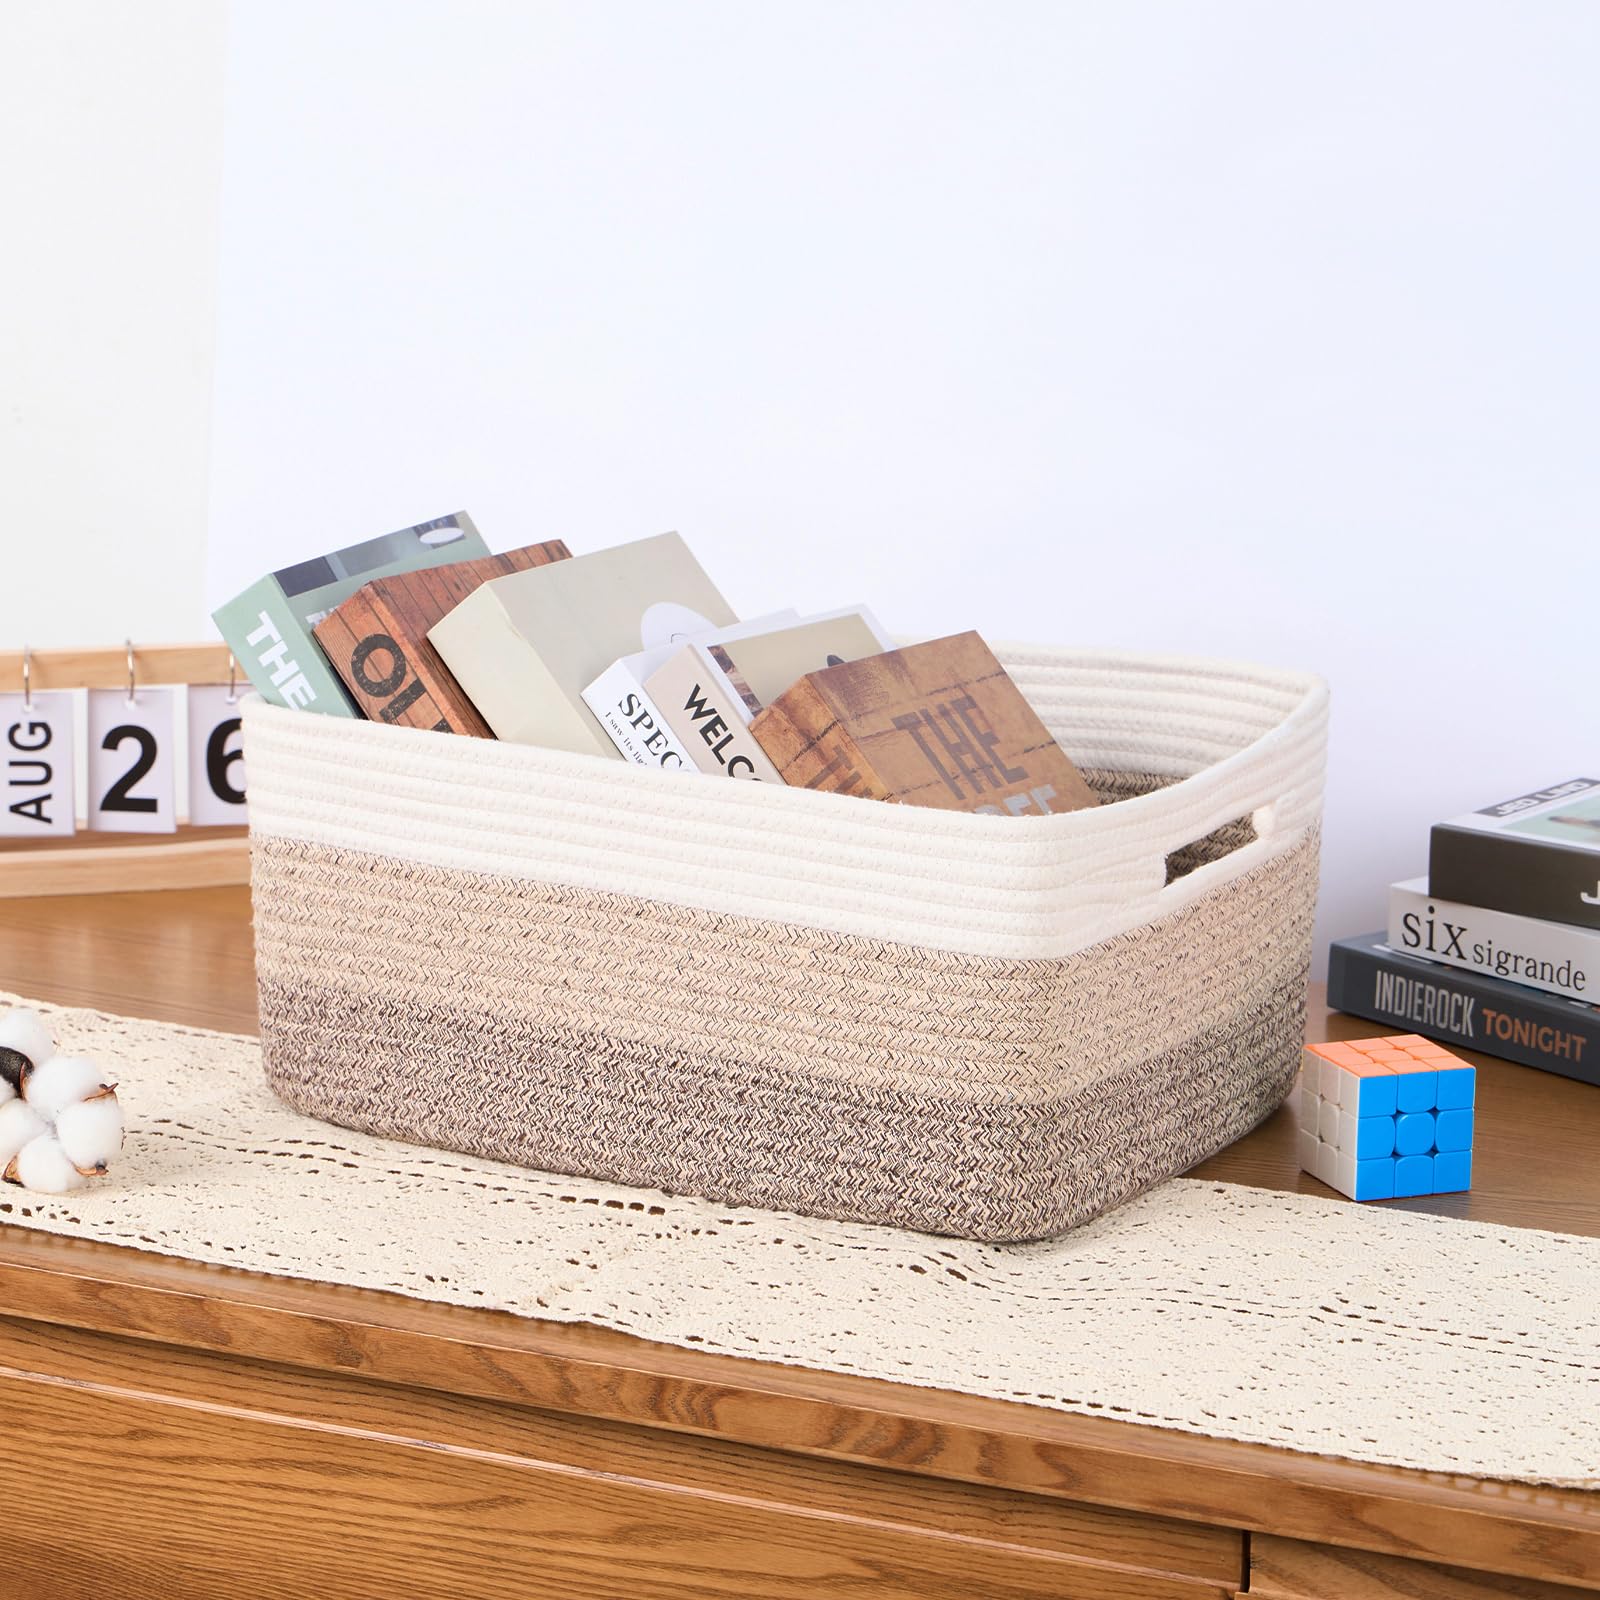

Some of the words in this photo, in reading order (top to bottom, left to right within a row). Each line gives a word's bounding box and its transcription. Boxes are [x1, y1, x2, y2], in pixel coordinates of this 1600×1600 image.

[246, 610, 317, 711] THE
[8, 721, 53, 824] AUG
[99, 724, 158, 814] 2
[206, 717, 247, 805] 6
[683, 683, 763, 781] WELC
[891, 695, 1029, 800] THE
[1472, 939, 1587, 992] sigrande
[1374, 970, 1476, 1038] INDIEROCK
[1482, 1007, 1588, 1063] TONIGHT
